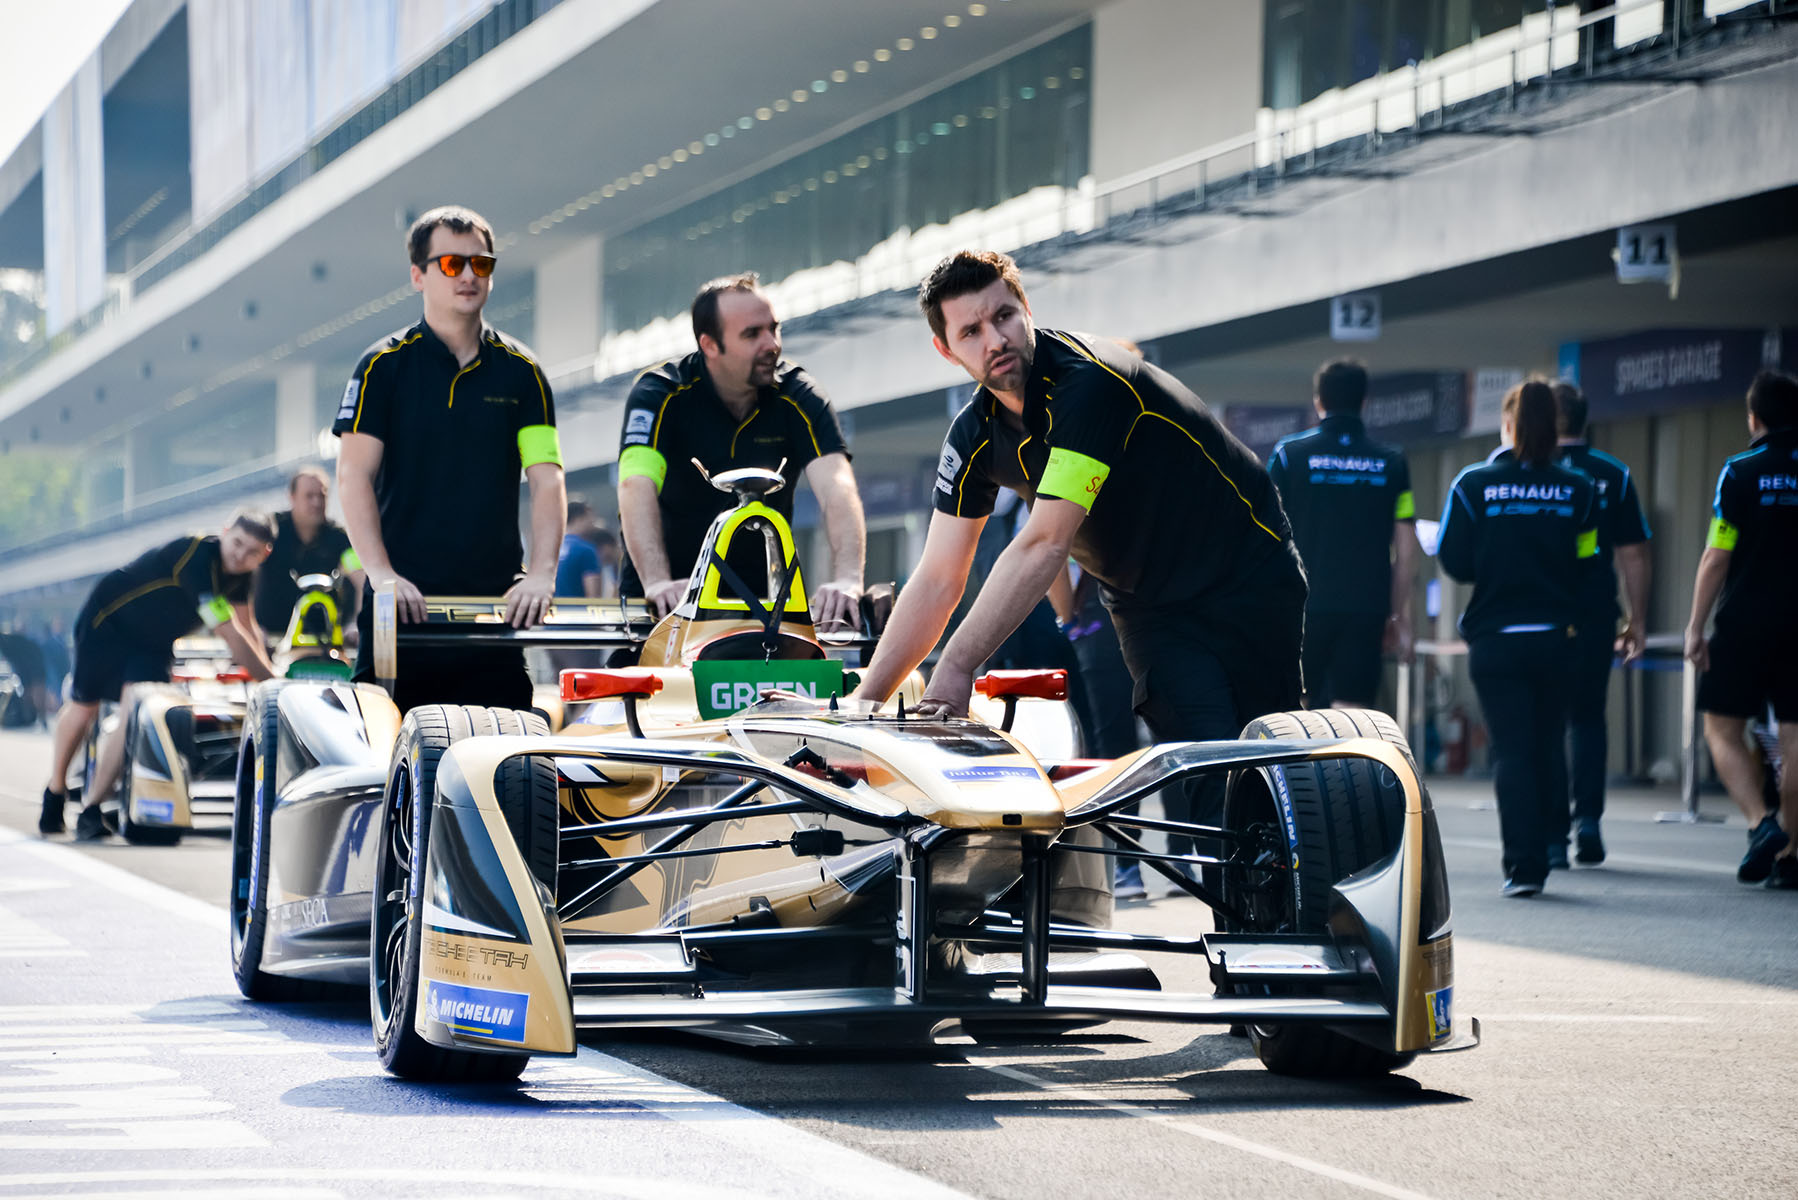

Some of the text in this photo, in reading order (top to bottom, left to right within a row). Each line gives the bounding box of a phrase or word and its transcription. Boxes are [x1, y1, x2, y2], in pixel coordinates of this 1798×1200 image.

[1628, 234, 1668, 265] 11
[1339, 301, 1375, 329] 12
[1668, 340, 1722, 386] GARAGE
[1308, 455, 1385, 472] RENAULT
[1484, 484, 1574, 501] RENAULT
[440, 999, 514, 1026] MICHELIN
